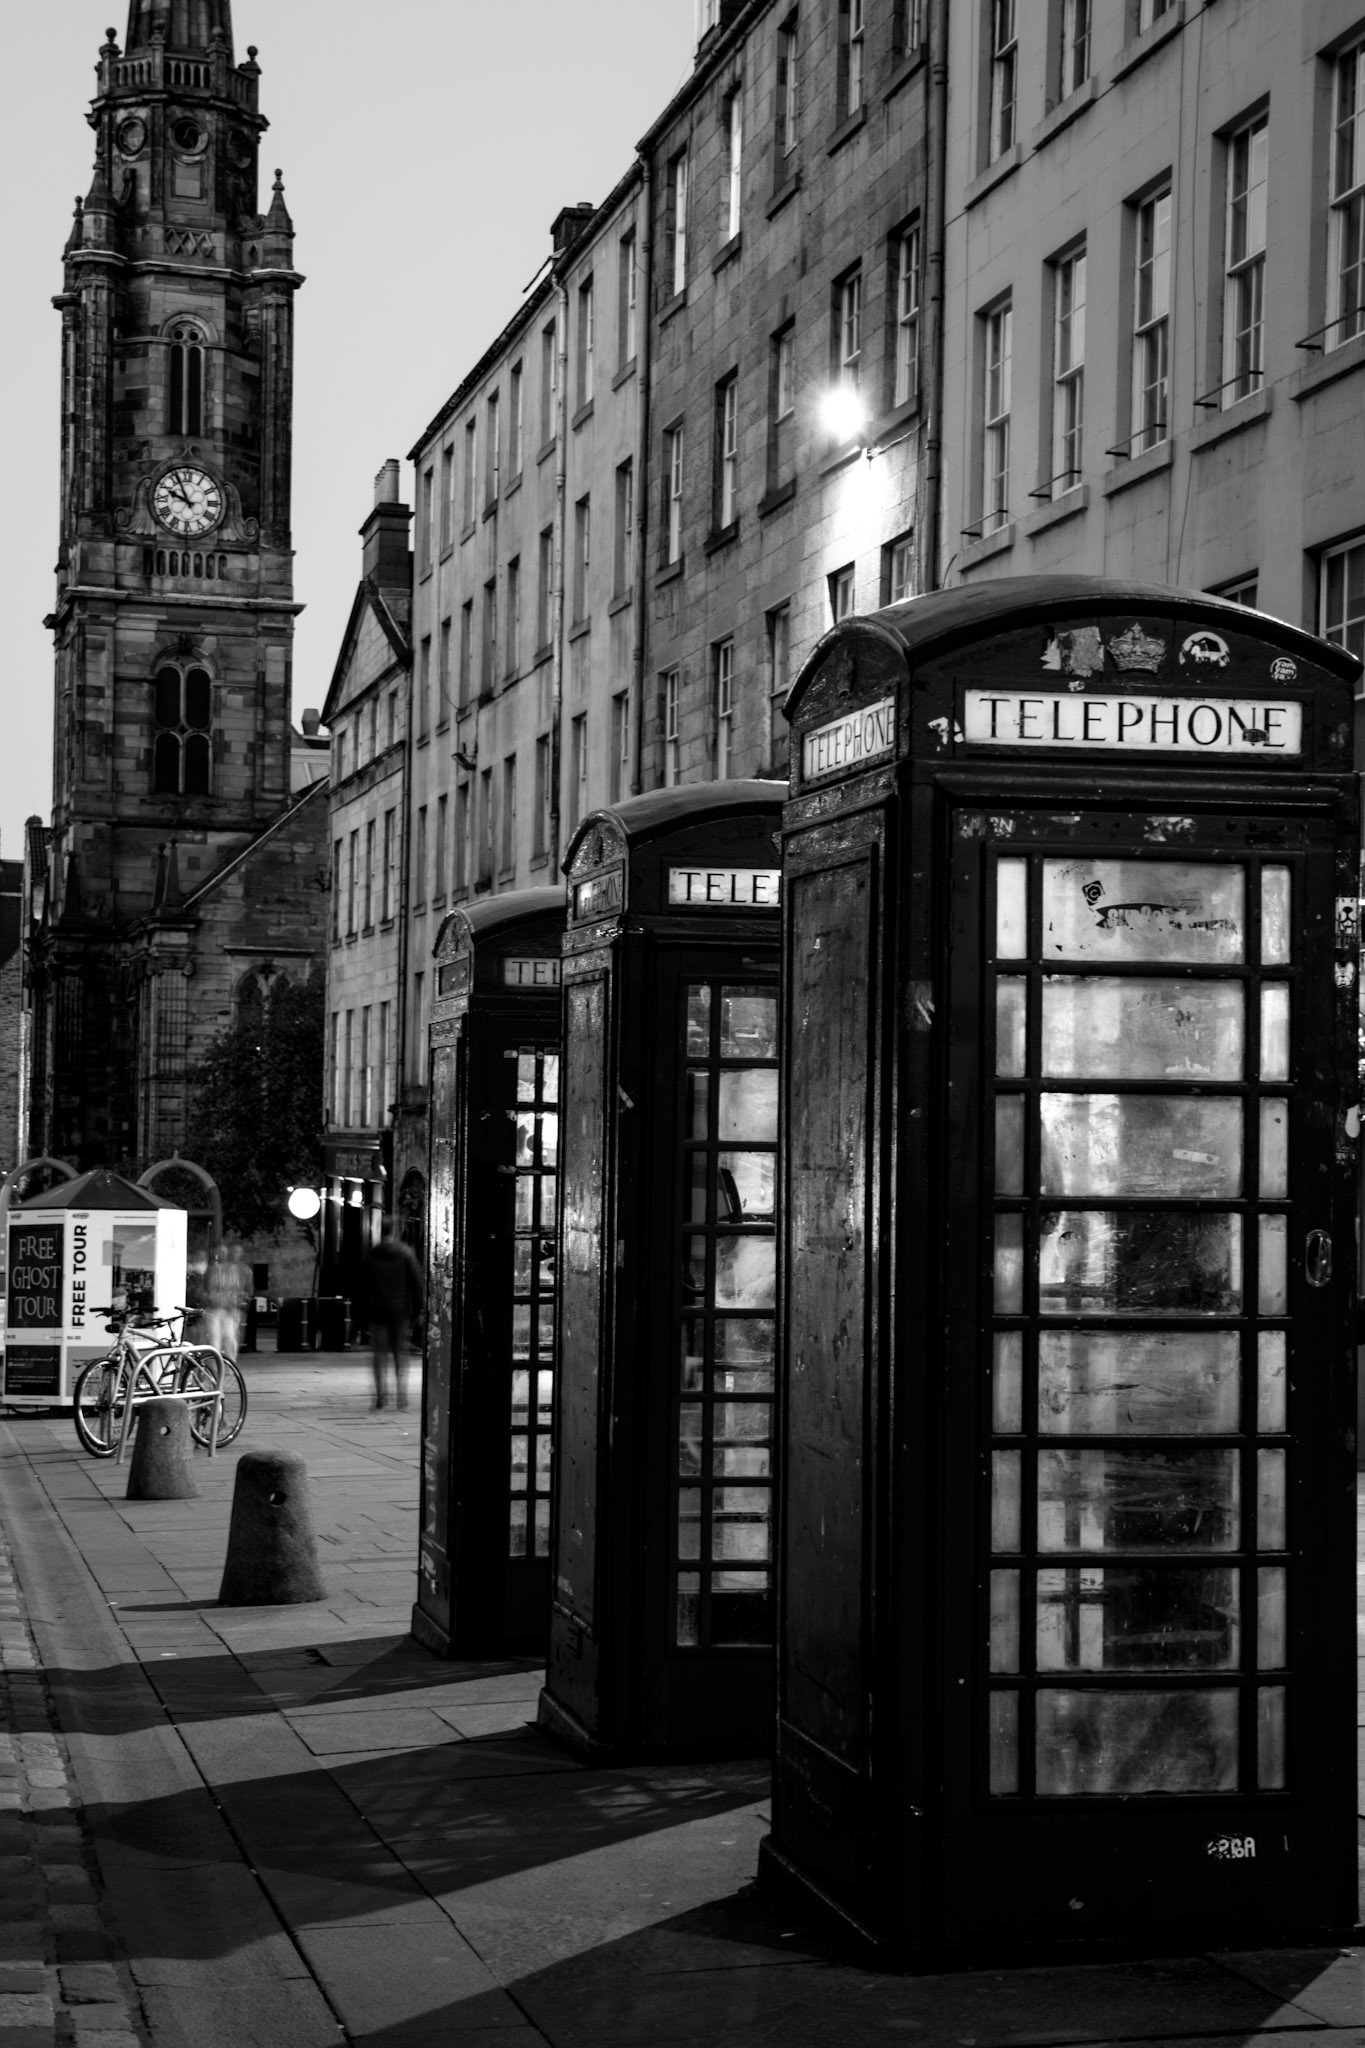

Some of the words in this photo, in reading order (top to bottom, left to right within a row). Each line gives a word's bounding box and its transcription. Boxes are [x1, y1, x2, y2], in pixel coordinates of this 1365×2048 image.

[808, 704, 896, 776] TELEPHONE
[979, 698, 1287, 749] TELEPHONE
[678, 872, 781, 904] TELE
[18, 1235, 55, 1260] FREE
[73, 1224, 87, 1275] TOUR
[12, 1265, 61, 1289] GHOST
[15, 1296, 58, 1319] TOUR
[72, 1280, 86, 1327] FREE
